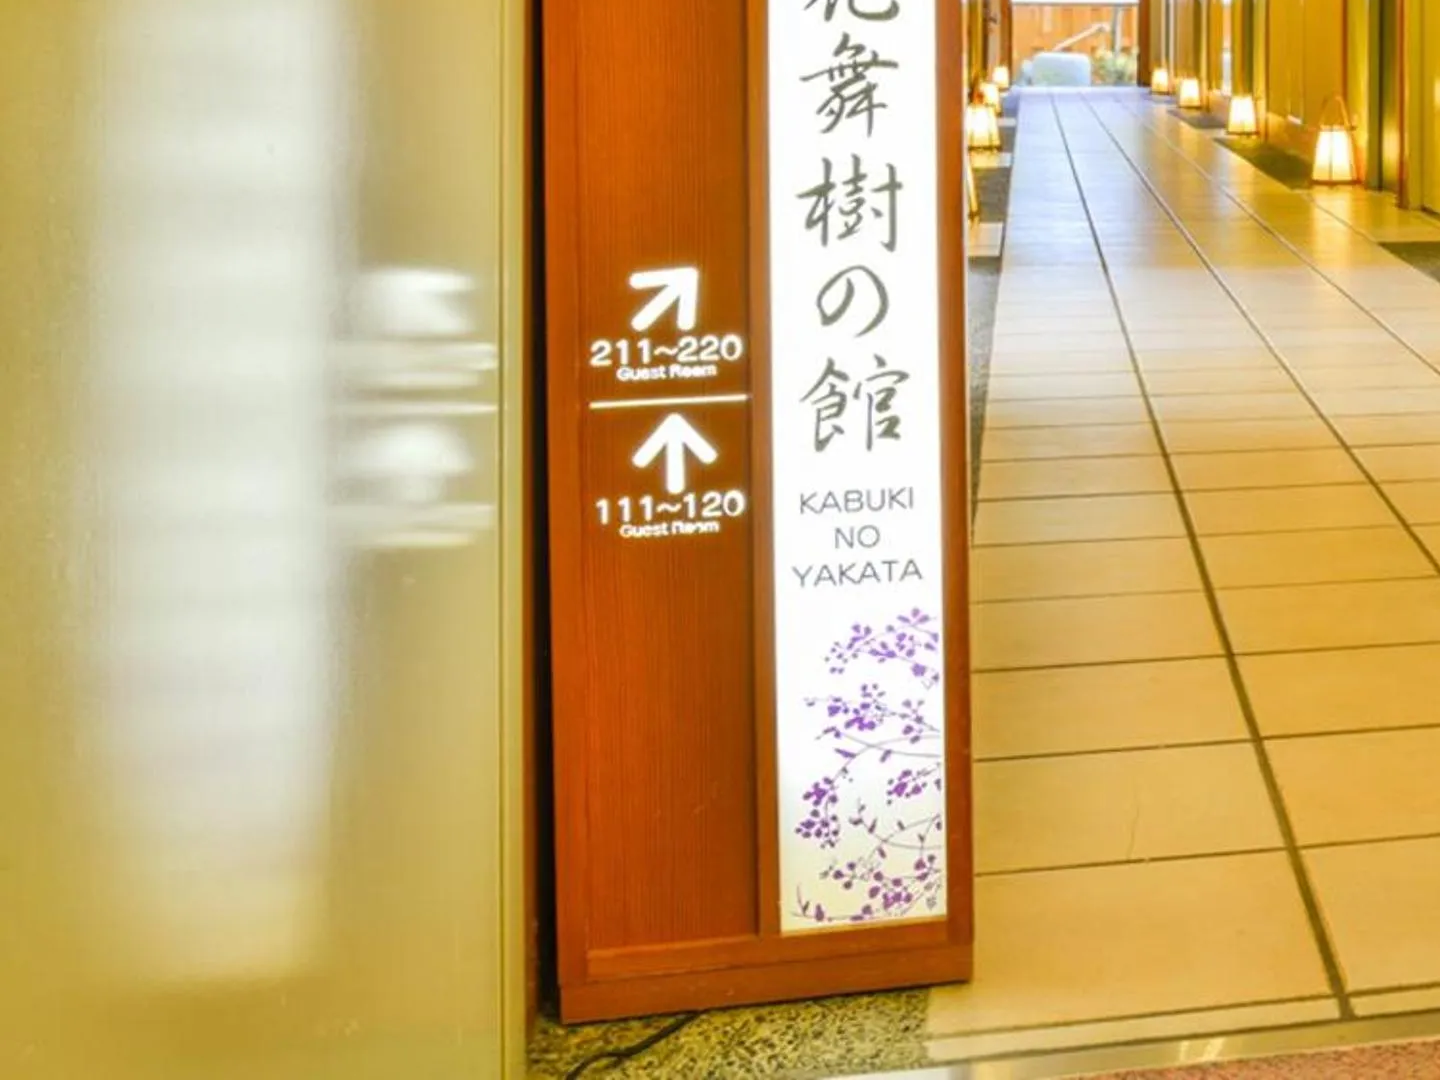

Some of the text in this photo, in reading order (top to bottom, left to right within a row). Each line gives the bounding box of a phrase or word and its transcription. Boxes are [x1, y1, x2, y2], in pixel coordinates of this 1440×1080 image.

[616, 364, 667, 382] Guest
[799, 487, 915, 515] KABUKI
[619, 522, 669, 539] Guest
[834, 525, 881, 550] NO
[792, 559, 923, 589] YAKATA
